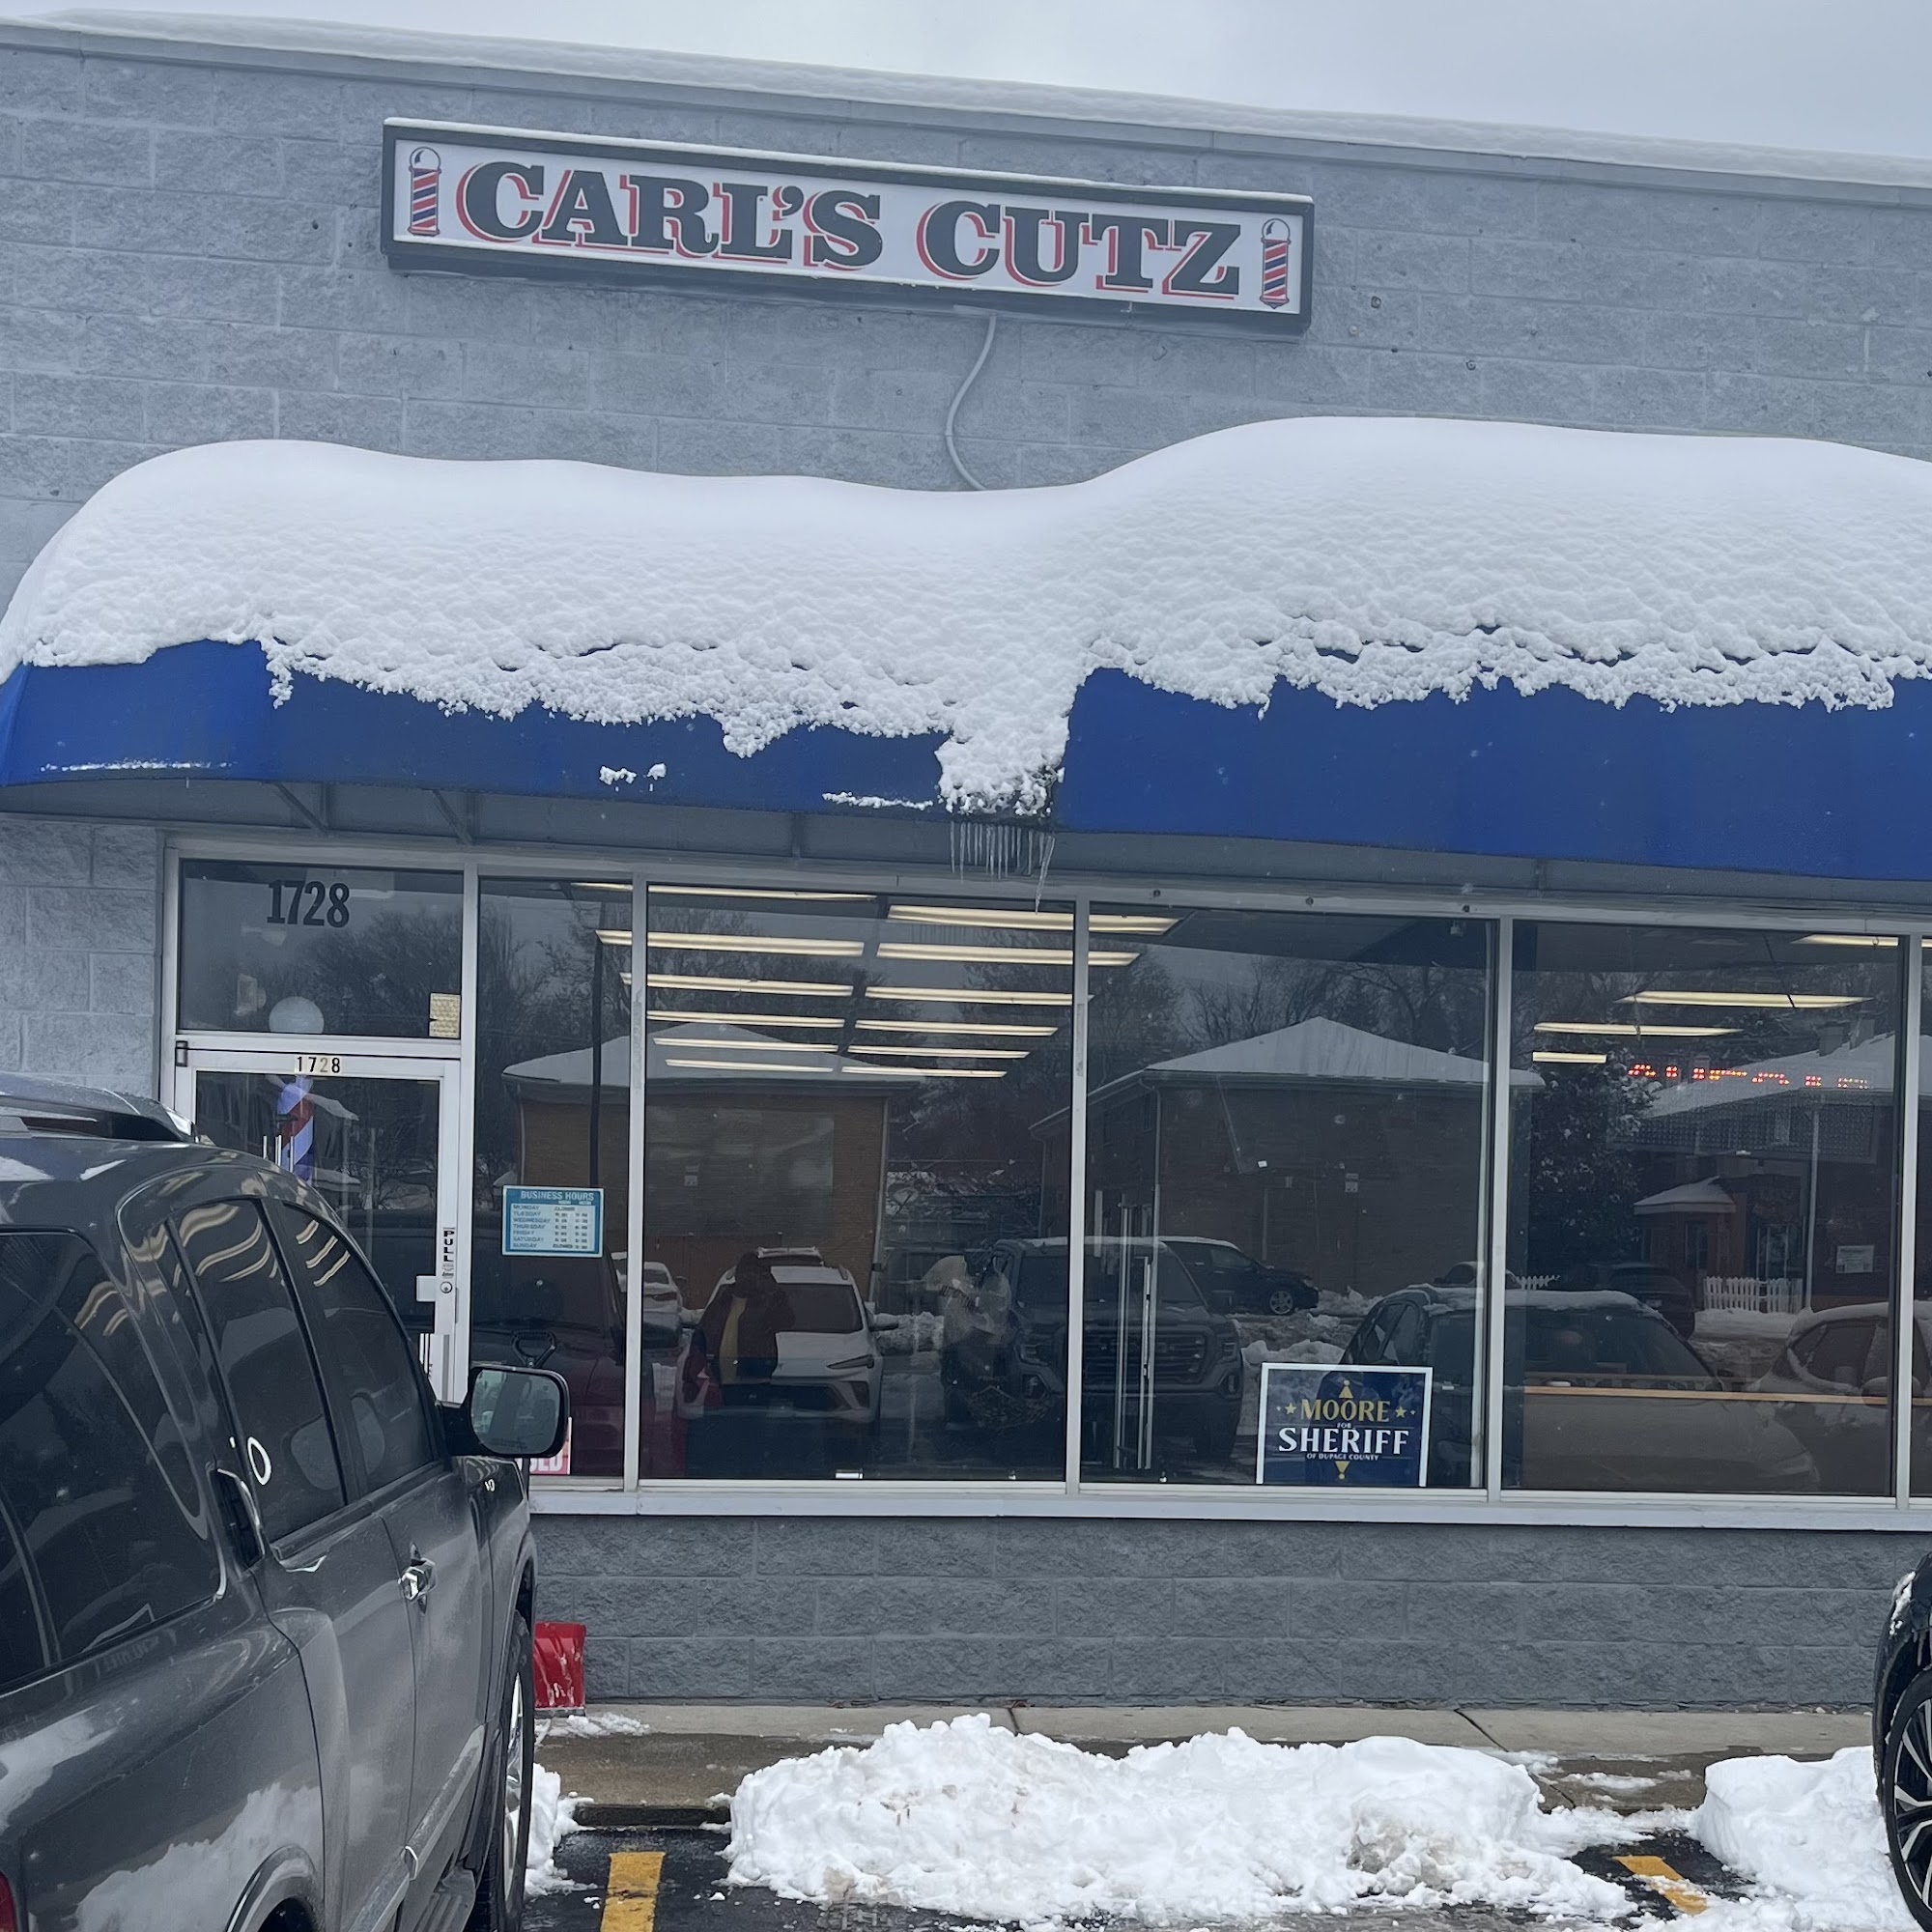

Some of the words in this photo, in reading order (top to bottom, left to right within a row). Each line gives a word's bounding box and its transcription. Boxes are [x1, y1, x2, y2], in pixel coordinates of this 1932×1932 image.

[456, 159, 884, 270] CARL'S
[917, 199, 1241, 299] CUTZ
[267, 879, 350, 928] 1728
[297, 1056, 341, 1073] 1728
[521, 1190, 563, 1200] BUSINESS
[565, 1192, 594, 1201] HOURS
[443, 1230, 455, 1263] PULL
[1300, 1399, 1390, 1422] MOORE
[1278, 1427, 1409, 1455] SHERIFF
